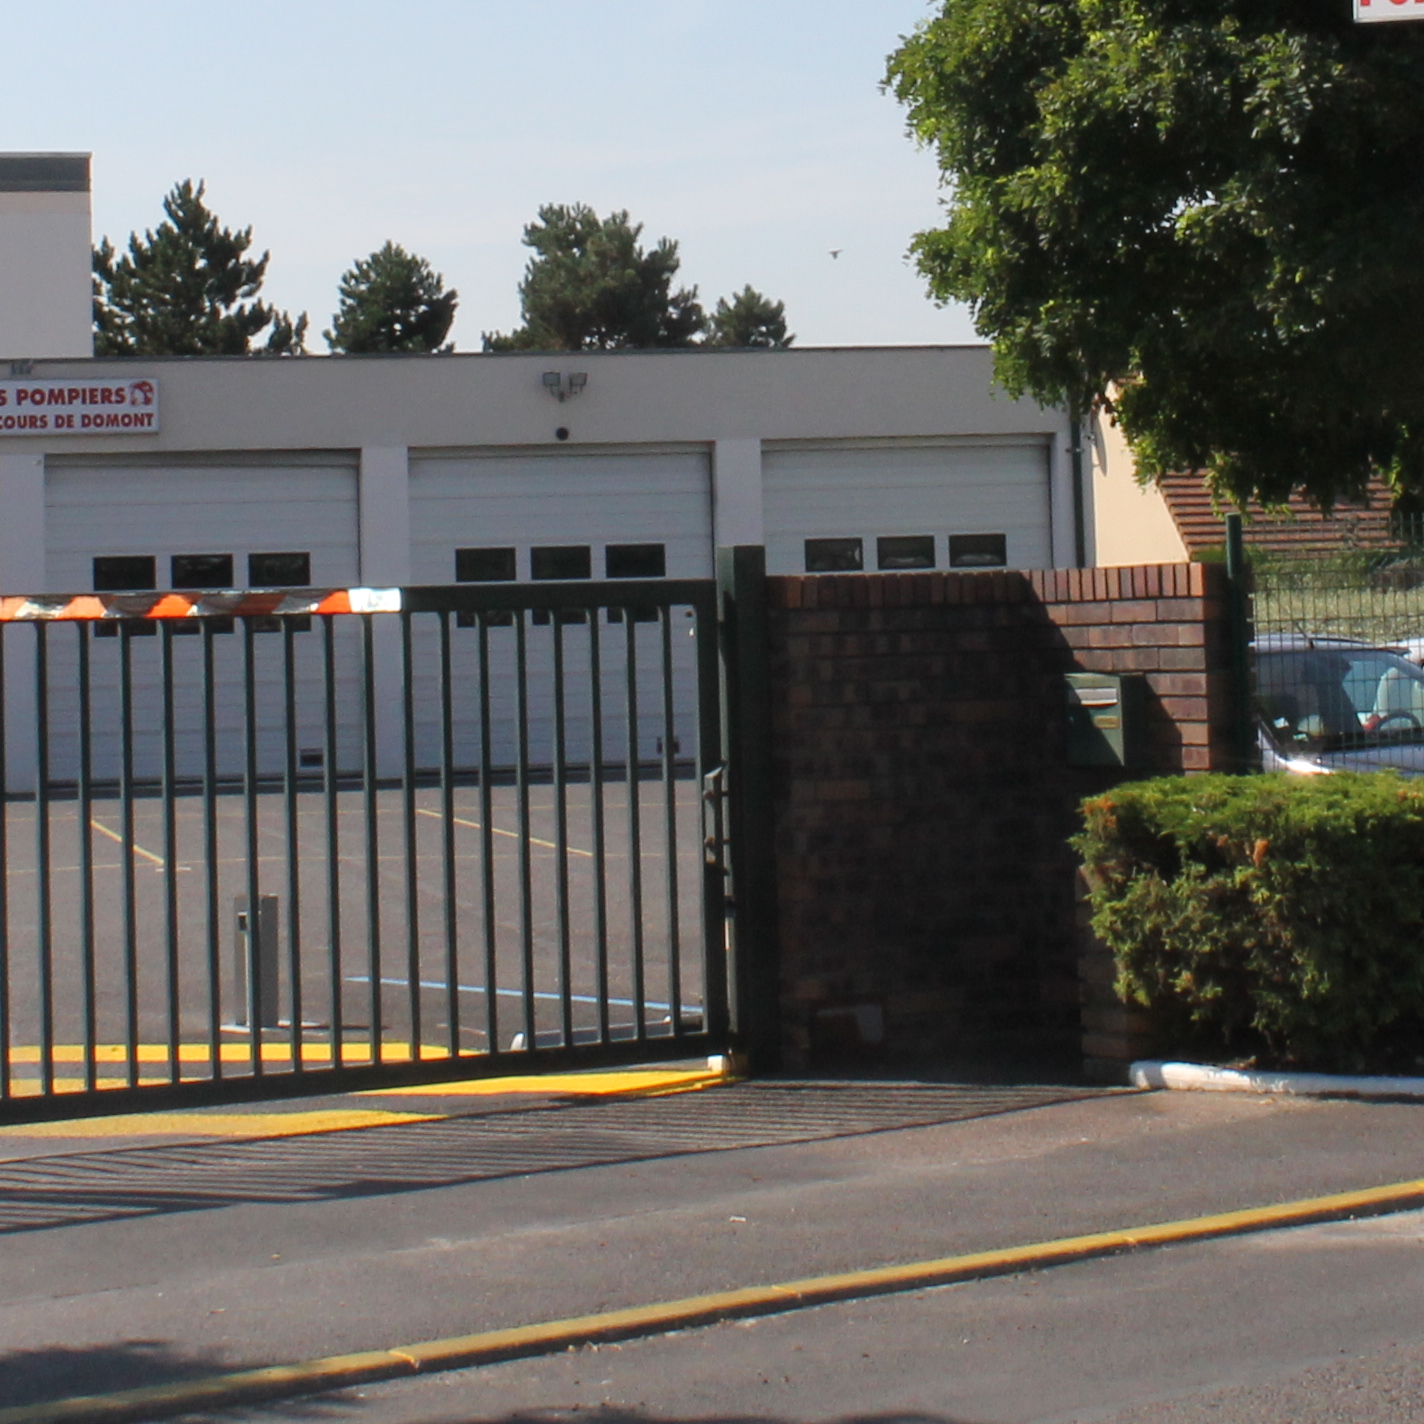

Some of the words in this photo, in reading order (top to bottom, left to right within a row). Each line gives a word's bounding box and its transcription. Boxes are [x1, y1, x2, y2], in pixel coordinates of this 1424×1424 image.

[16, 386, 126, 406] POMPIERS
[55, 413, 74, 429] DE
[81, 412, 154, 428] DOMONT
